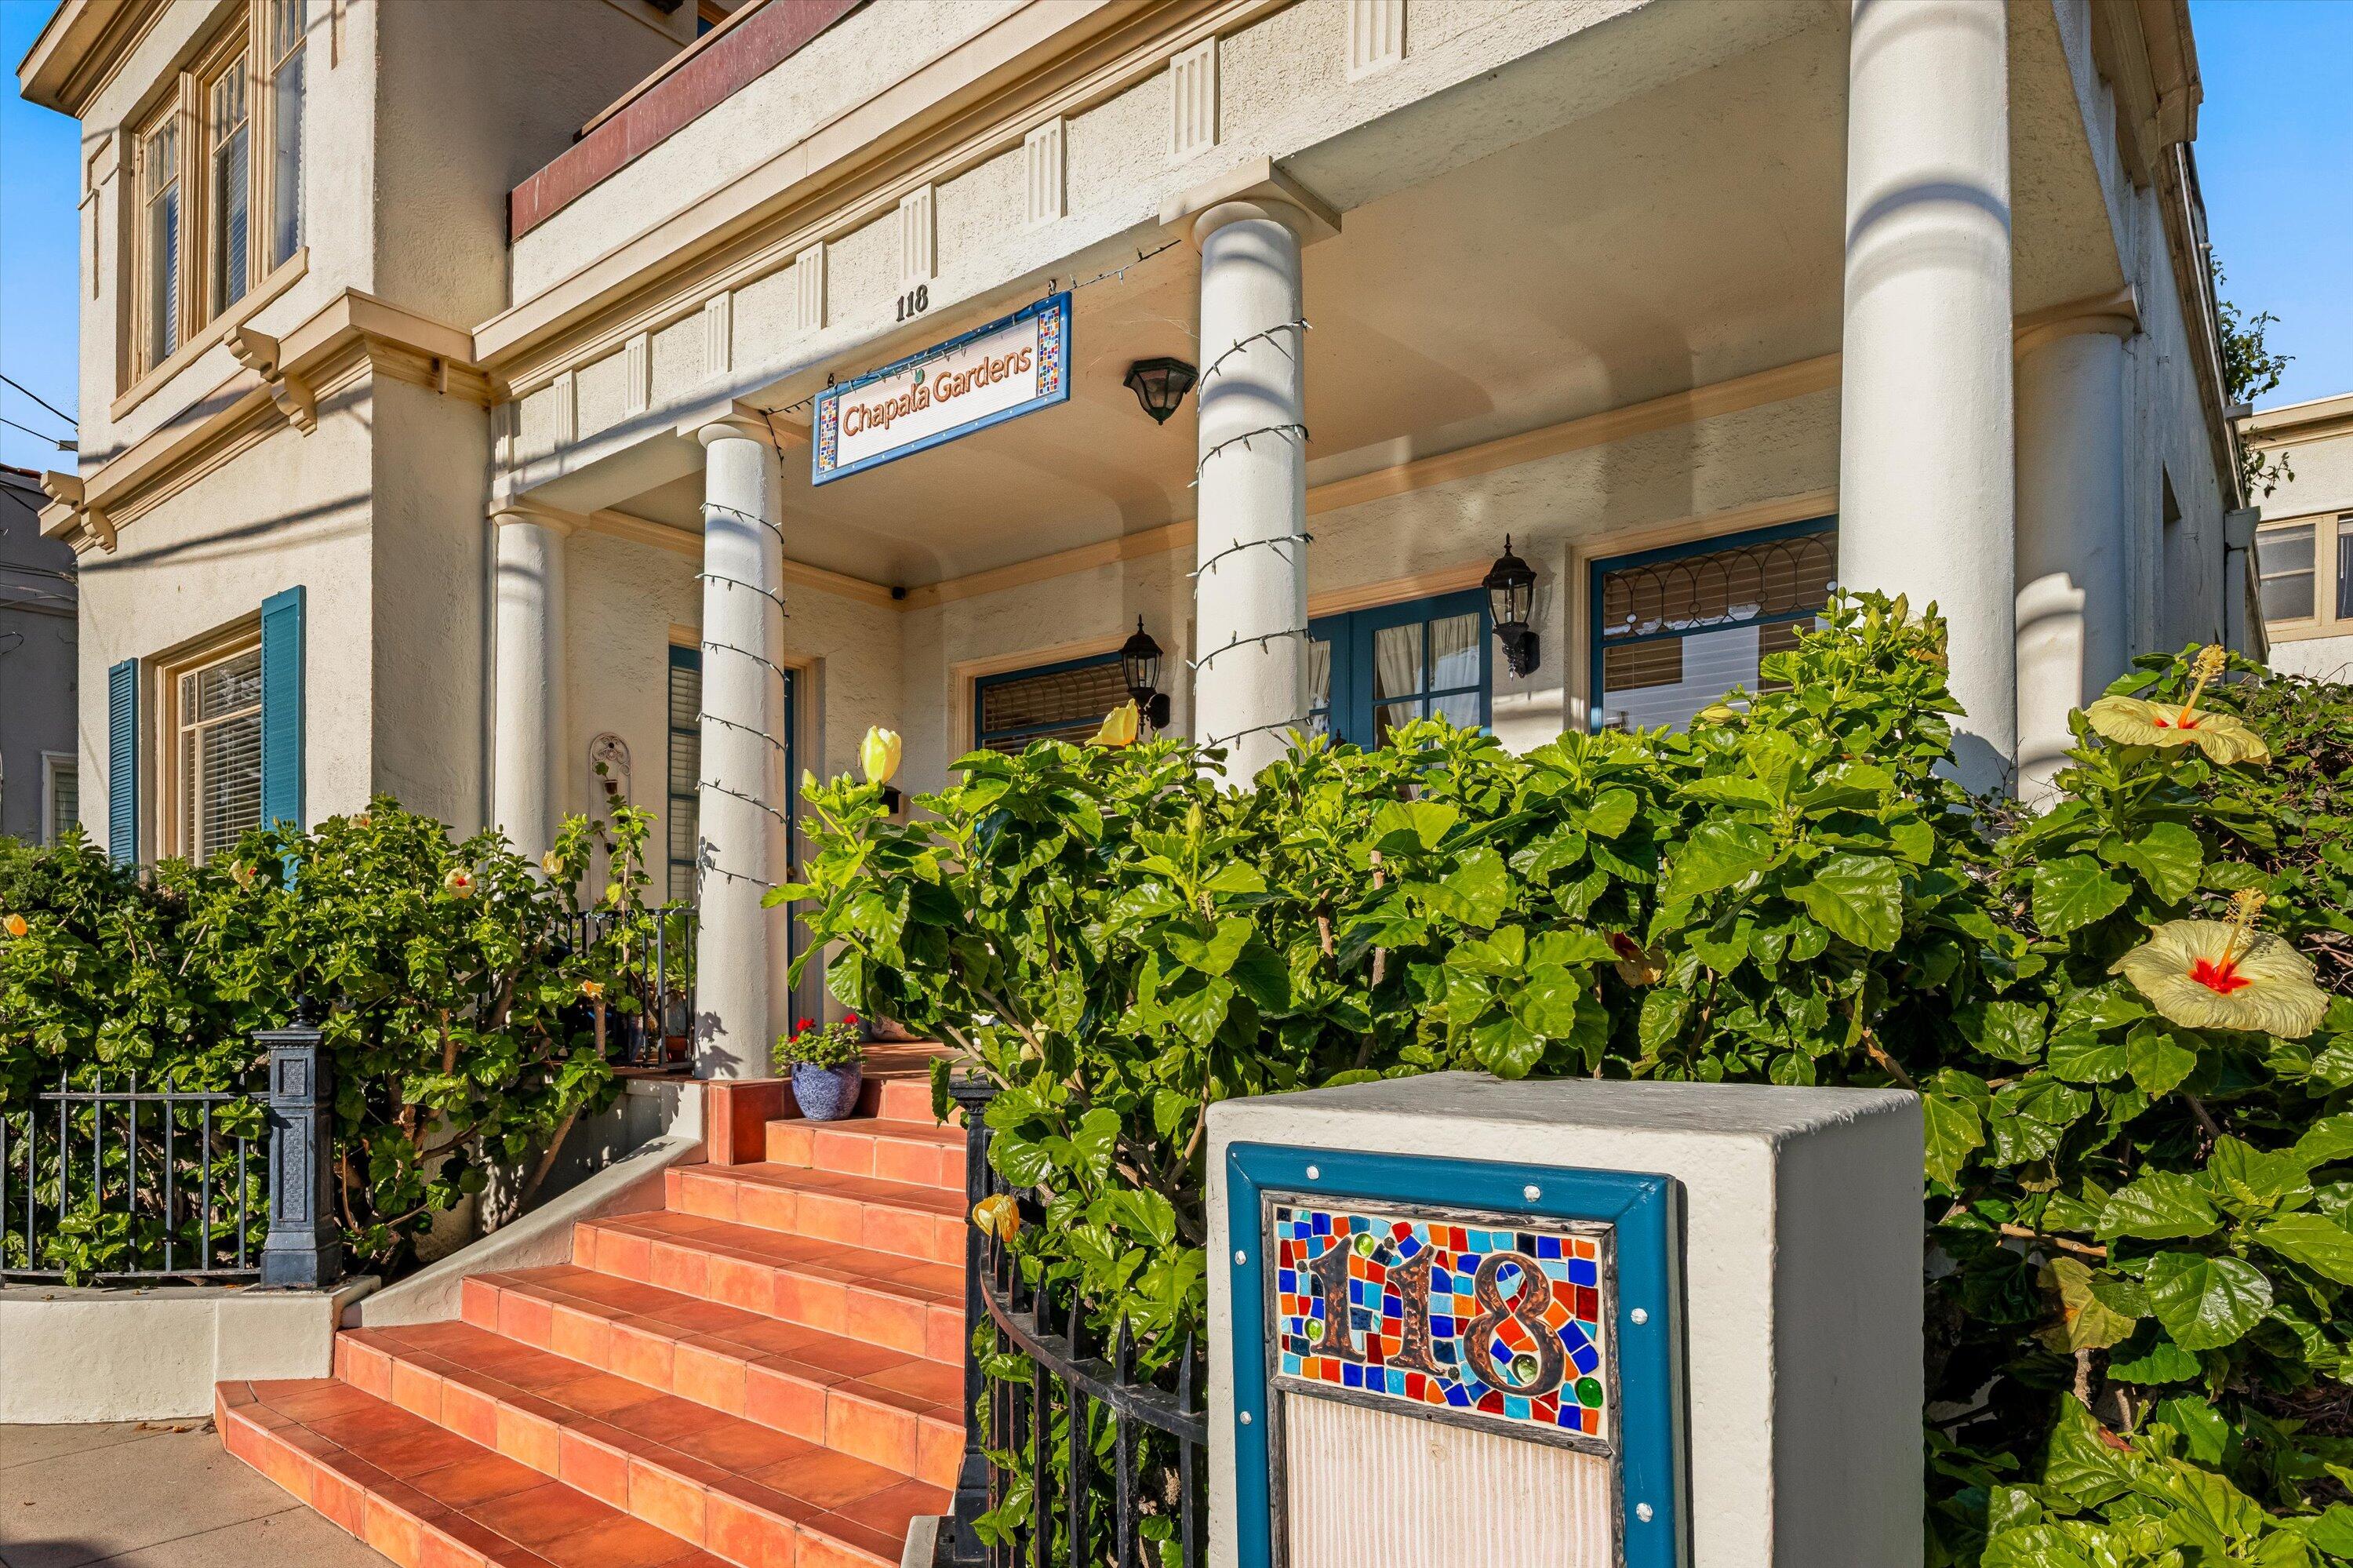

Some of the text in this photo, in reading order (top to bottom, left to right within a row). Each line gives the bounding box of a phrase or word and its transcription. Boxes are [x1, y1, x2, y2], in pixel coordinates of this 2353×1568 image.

[896, 283, 929, 322] 118
[843, 347, 1031, 436] Chapala Gardens
[1310, 1237, 1564, 1395] 118
